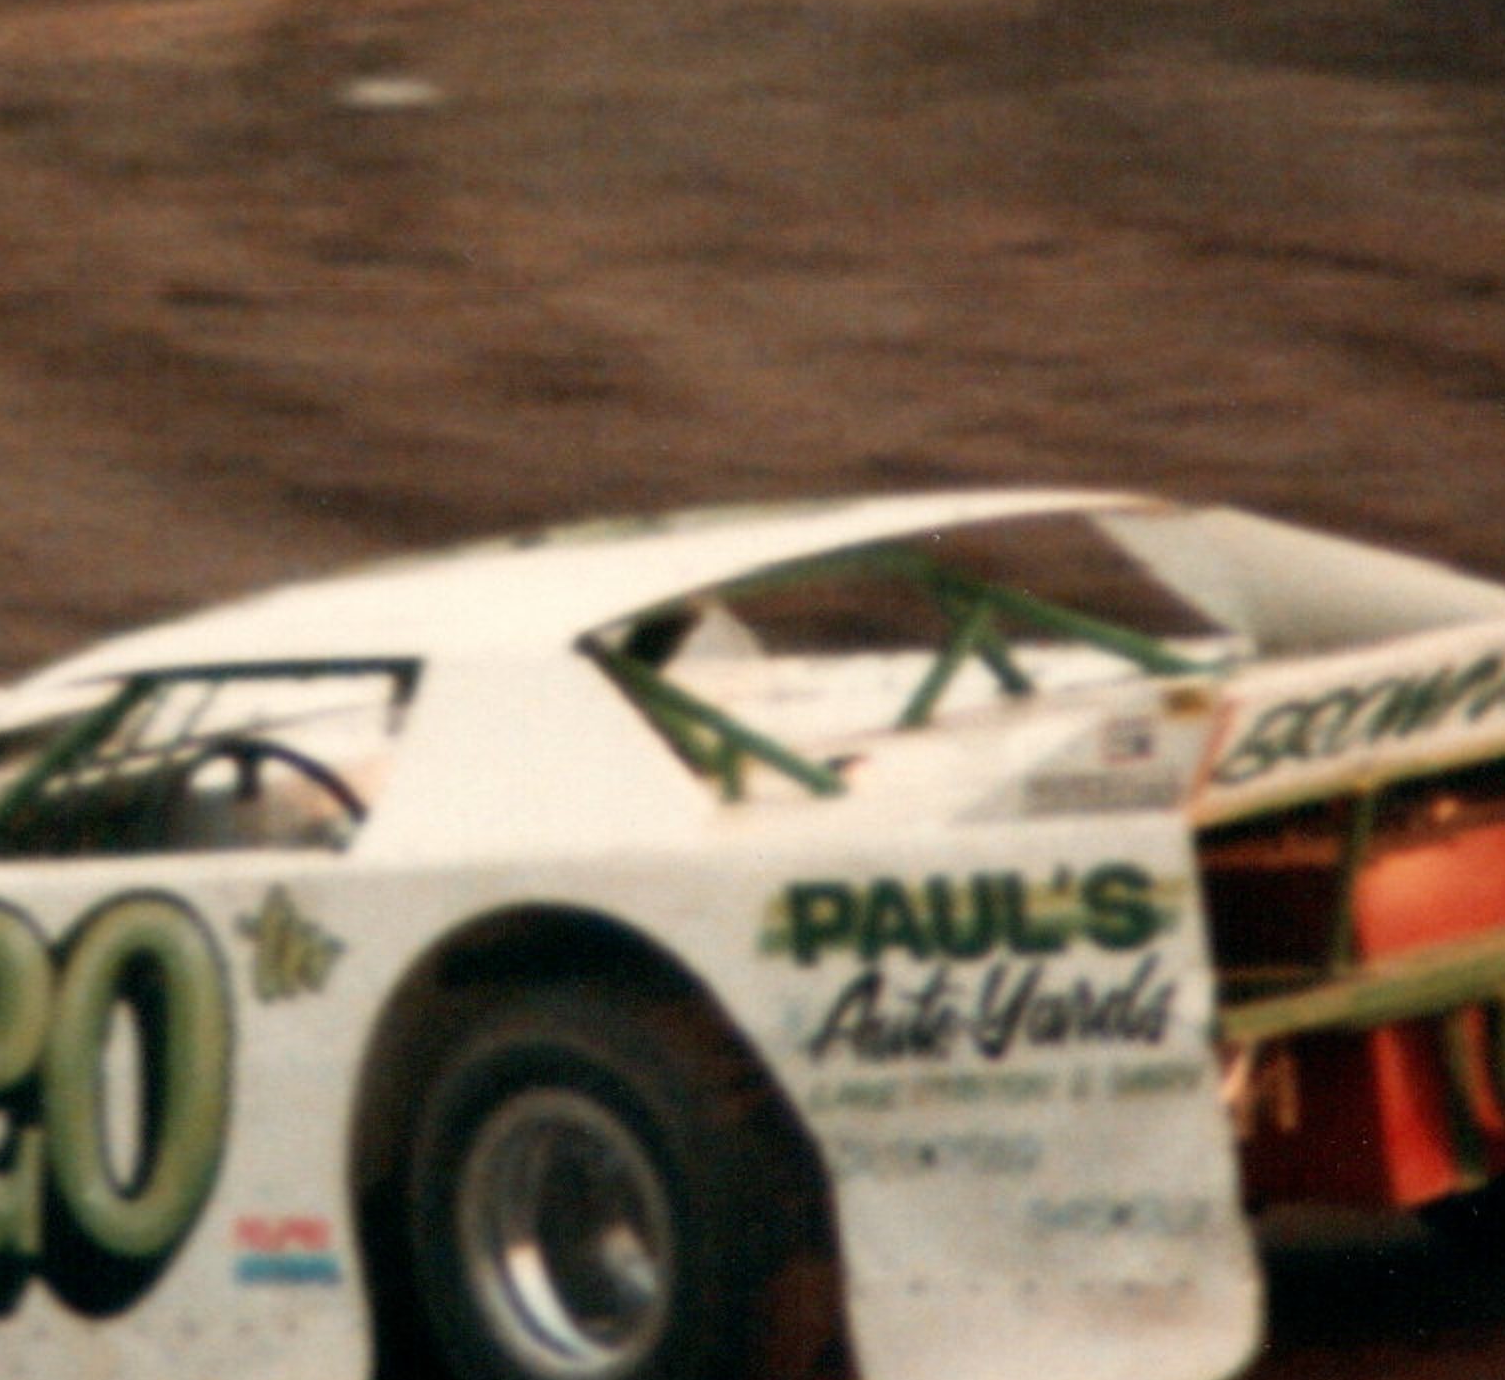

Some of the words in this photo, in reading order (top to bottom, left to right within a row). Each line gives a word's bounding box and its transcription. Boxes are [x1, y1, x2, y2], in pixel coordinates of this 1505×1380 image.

[785, 862, 1159, 967] PAUL'S
[808, 963, 959, 1063] Auto
[969, 951, 1178, 1061] Yards
